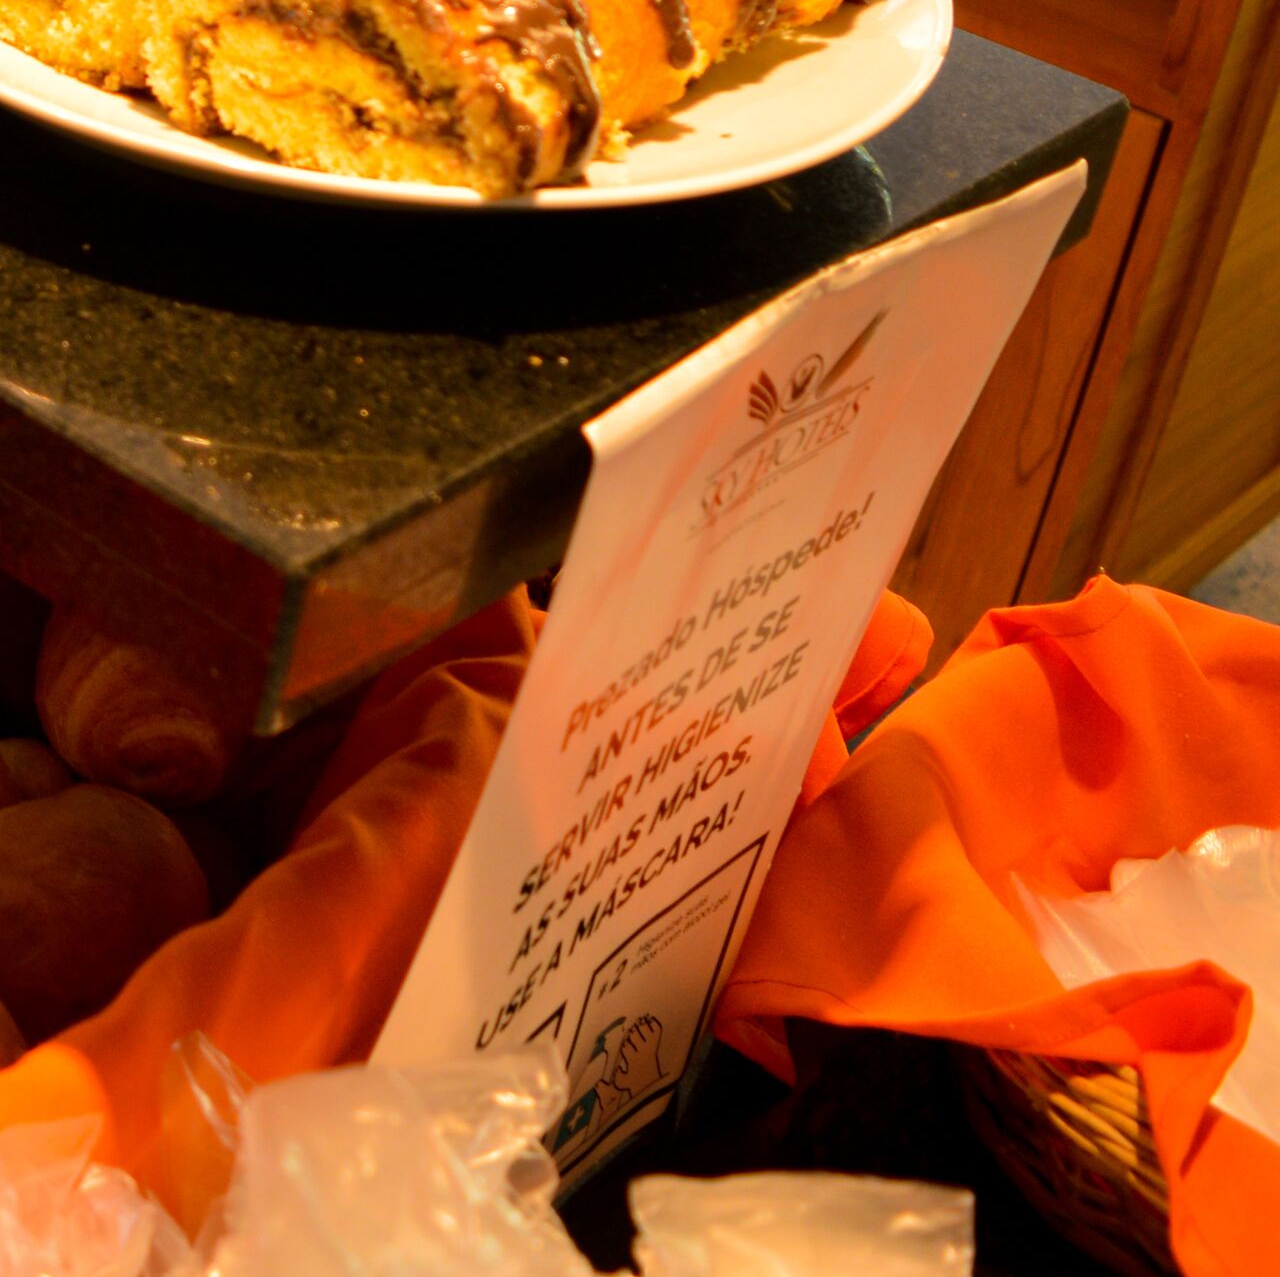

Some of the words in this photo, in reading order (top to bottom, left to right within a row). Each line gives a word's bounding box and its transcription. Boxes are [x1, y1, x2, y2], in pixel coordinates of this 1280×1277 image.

[560, 615, 697, 753] Prezado
[702, 490, 875, 630] Hóspede!
[576, 668, 694, 795] ANTES
[695, 627, 749, 692] DE
[748, 595, 801, 654] SE
[508, 899, 555, 975] AS
[556, 813, 647, 918] SUAS
[647, 734, 753, 836] MÃOS.
[513, 774, 633, 914] SERVIR
[635, 640, 810, 796] HIGIENIZE
[474, 962, 543, 1051] USE
[540, 940, 563, 987] A
[568, 789, 745, 957] MÁSCARA!
